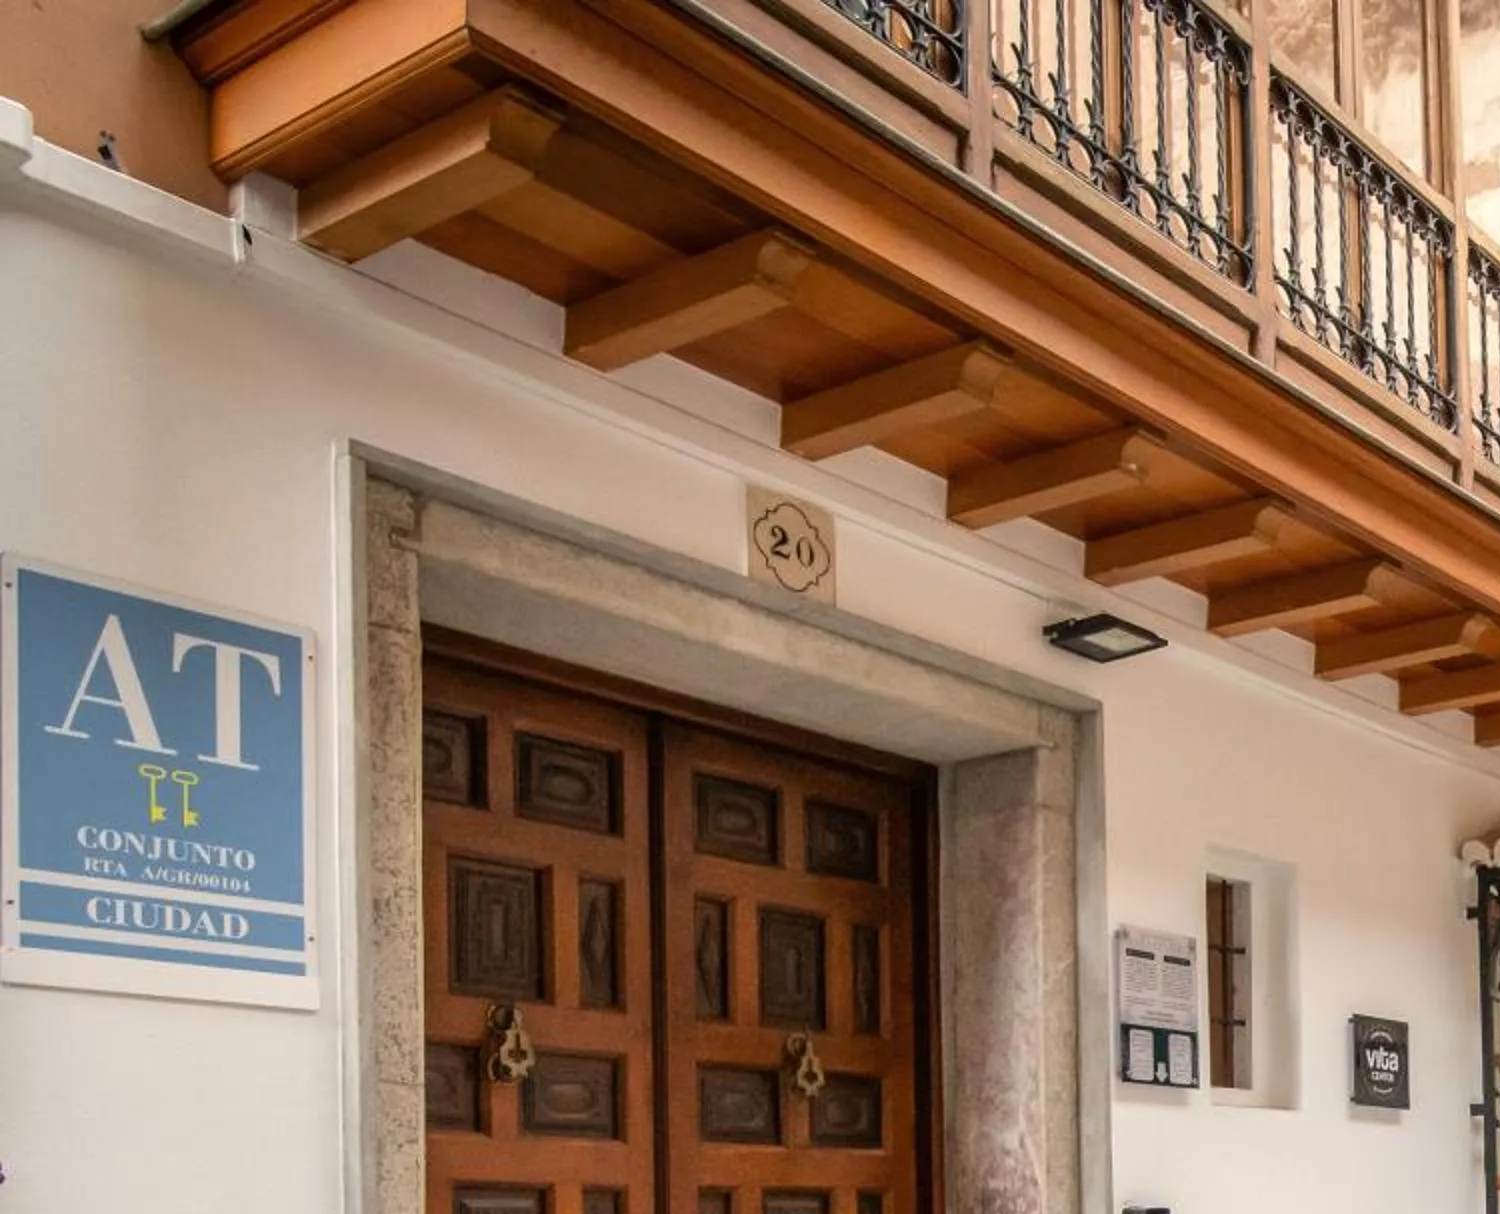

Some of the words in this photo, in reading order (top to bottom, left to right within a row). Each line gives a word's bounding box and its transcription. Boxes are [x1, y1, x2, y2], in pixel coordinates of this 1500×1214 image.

[770, 525, 815, 568] 20
[44, 613, 282, 771] AT
[77, 825, 256, 871] CONJUNTO
[84, 857, 127, 877] RTA
[86, 897, 249, 939] CIUDAD
[1365, 1045, 1399, 1071] vita
